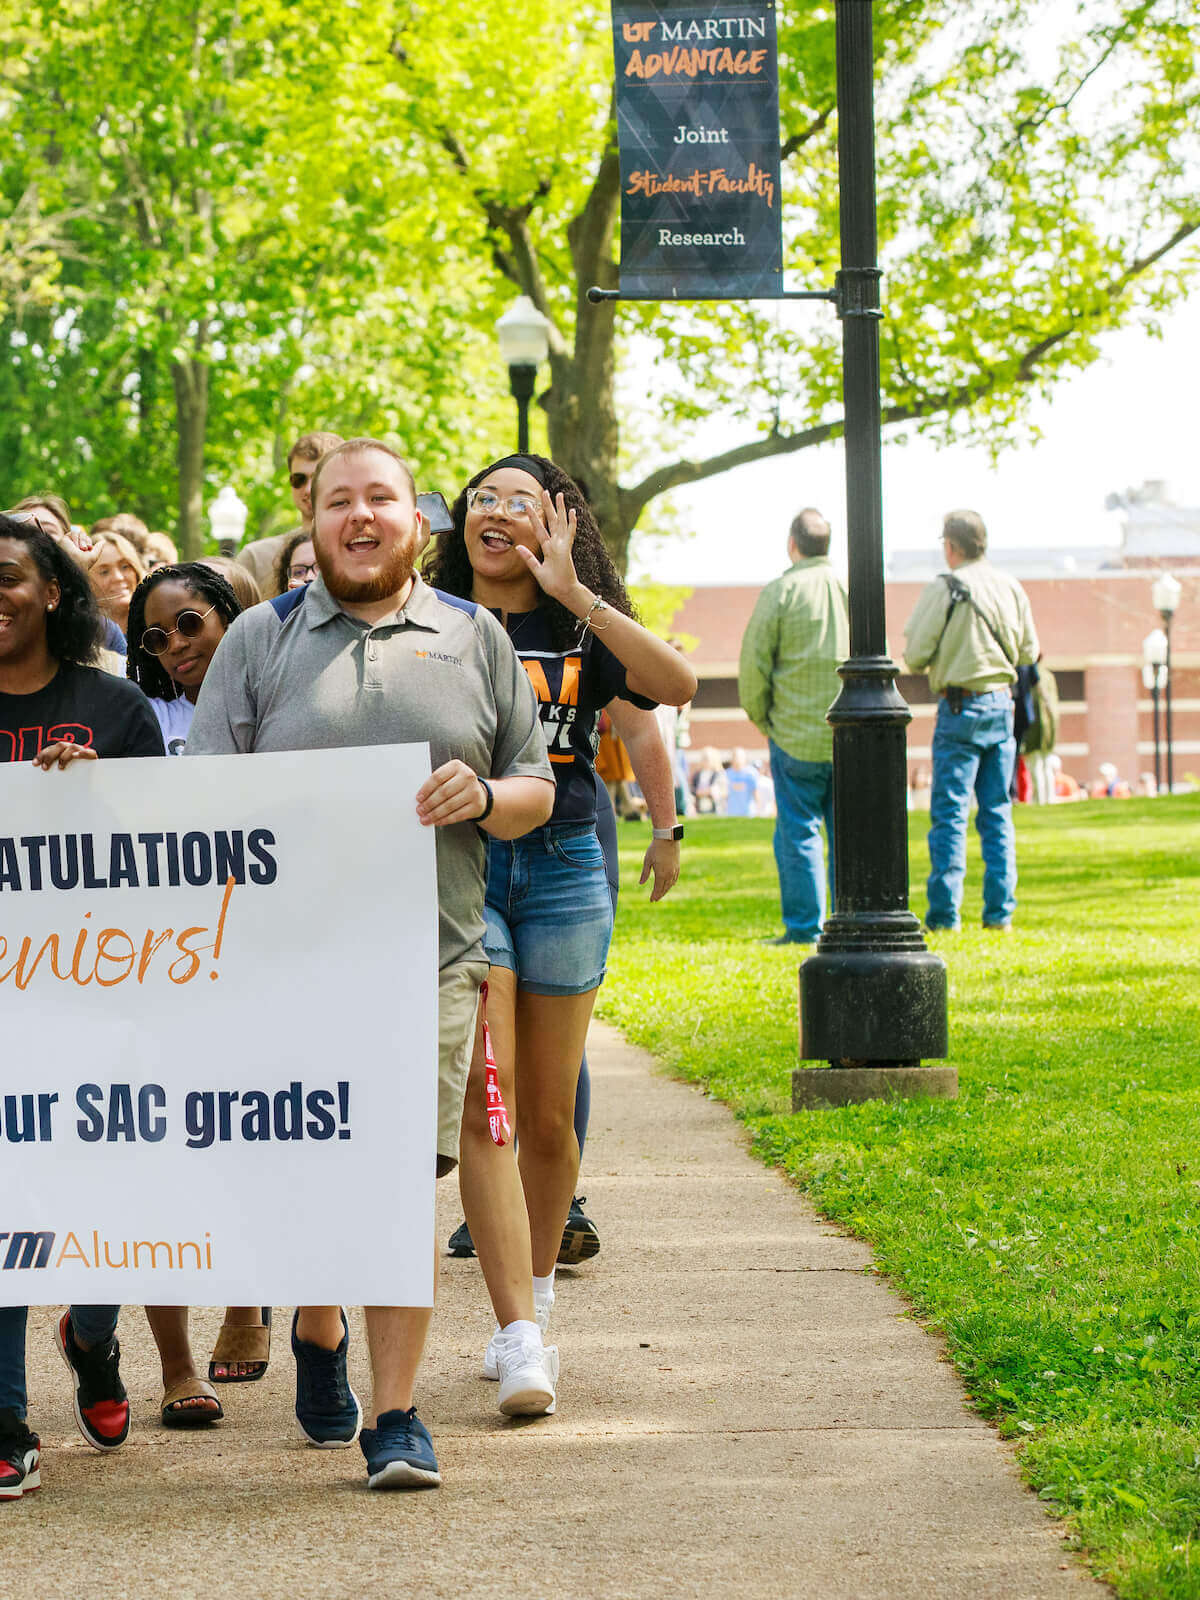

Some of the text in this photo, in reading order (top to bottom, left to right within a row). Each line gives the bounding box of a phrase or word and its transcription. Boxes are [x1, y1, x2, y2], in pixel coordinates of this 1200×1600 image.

[622, 17, 766, 43] UT MARTIN
[625, 45, 768, 79] ADVANTAGE
[673, 125, 729, 144] Joint
[626, 162, 774, 208] Student-Faculty
[658, 227, 746, 246] Research
[75, 1083, 167, 1142] SAC
[185, 1081, 351, 1148] grads!
